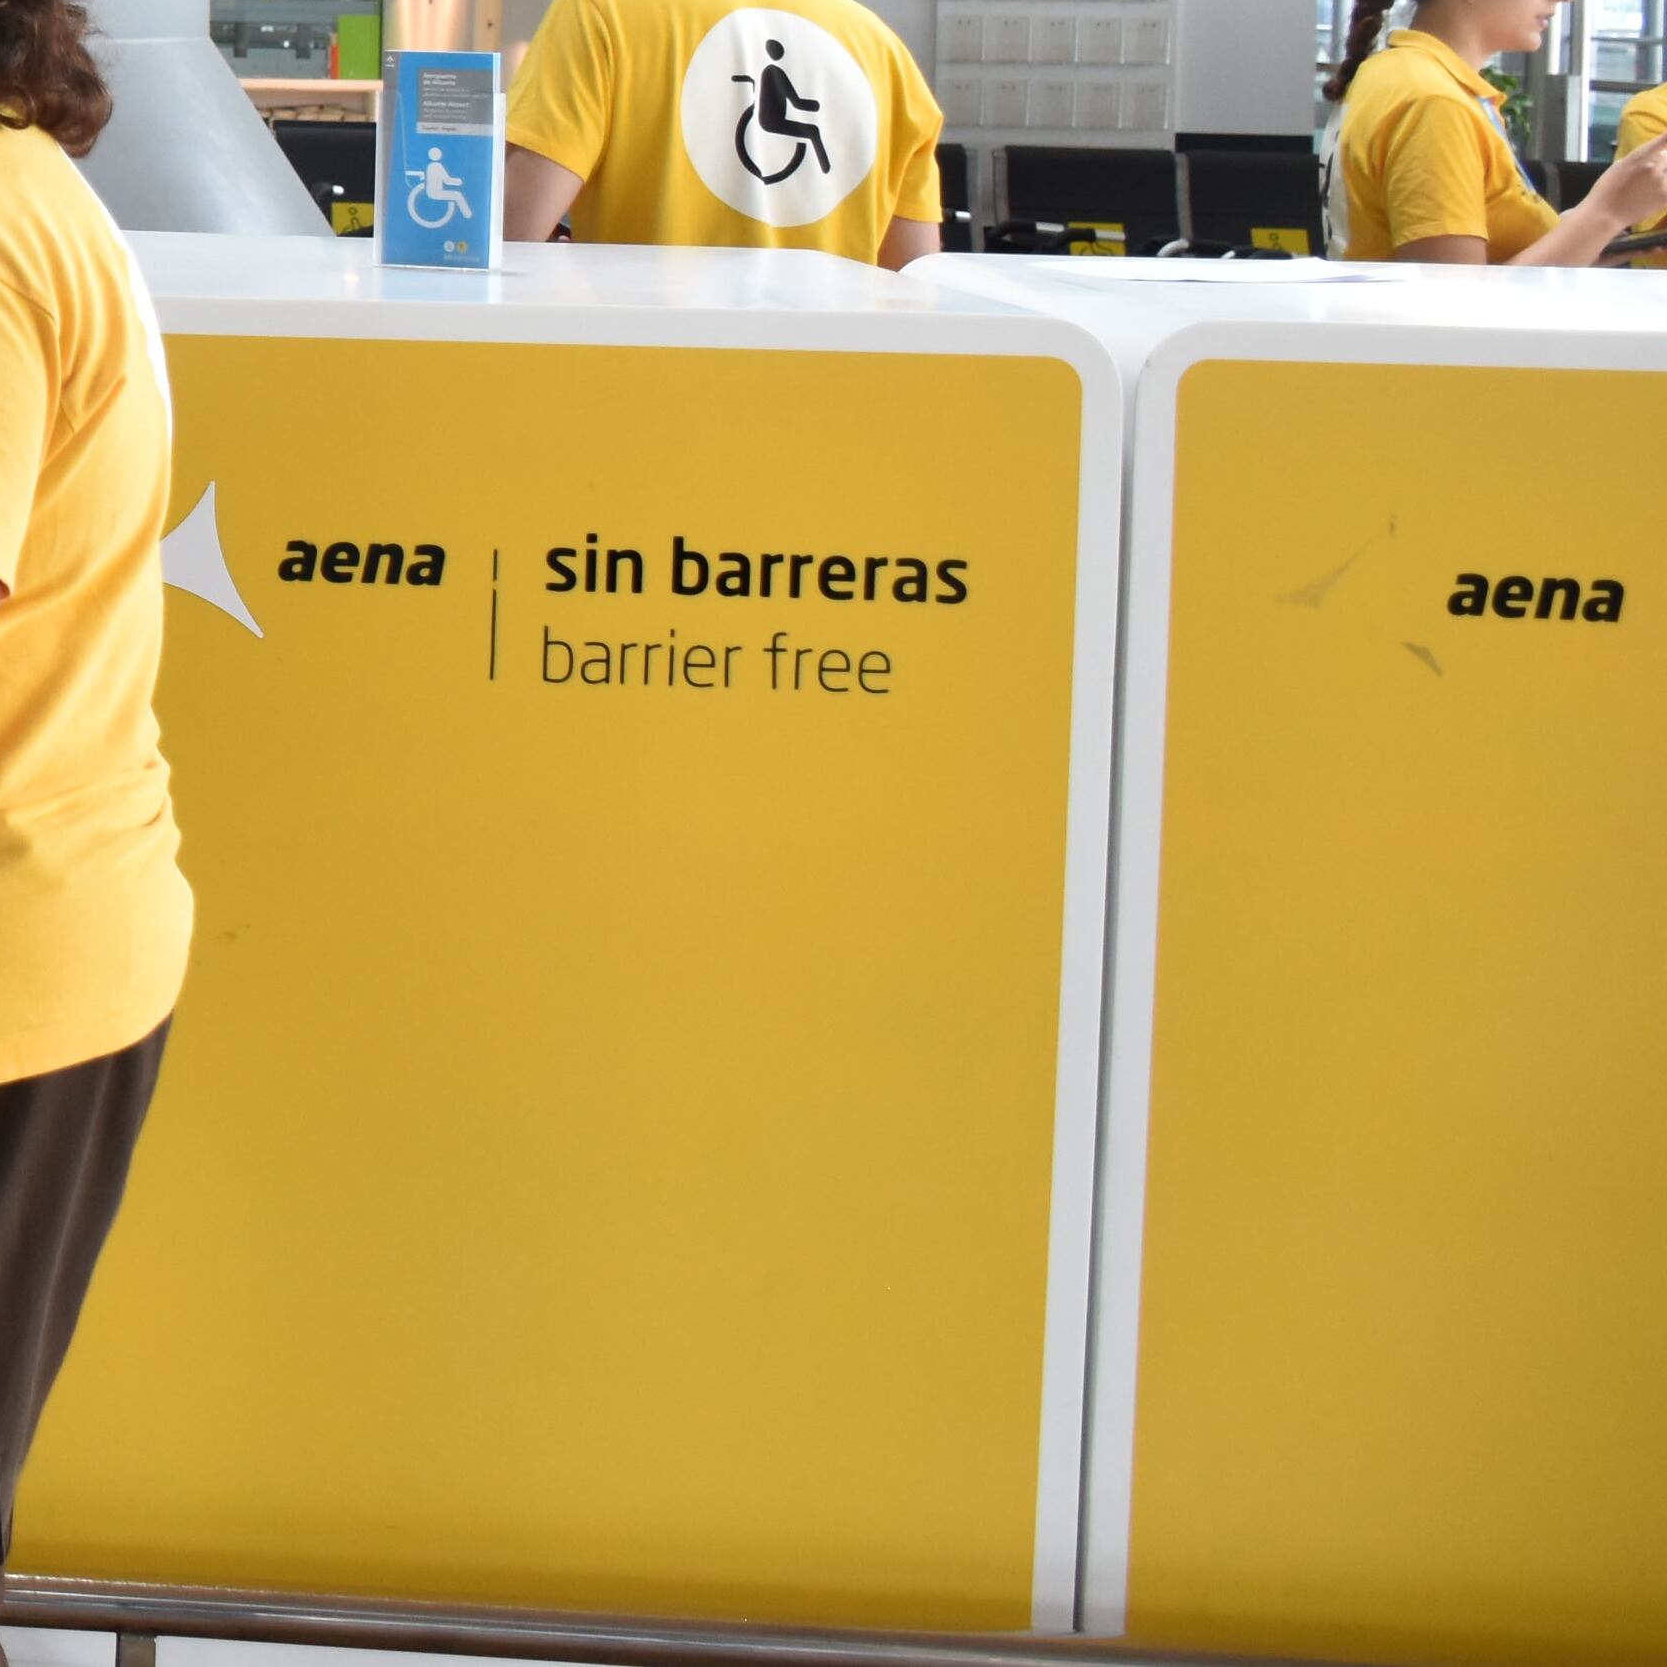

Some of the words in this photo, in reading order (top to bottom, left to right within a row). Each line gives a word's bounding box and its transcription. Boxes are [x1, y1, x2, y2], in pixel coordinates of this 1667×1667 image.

[278, 540, 446, 586] aena
[545, 533, 643, 594] sin
[671, 537, 968, 604] barreras
[1447, 573, 1624, 623] aena
[542, 624, 742, 688] barrier
[764, 631, 892, 694] free
